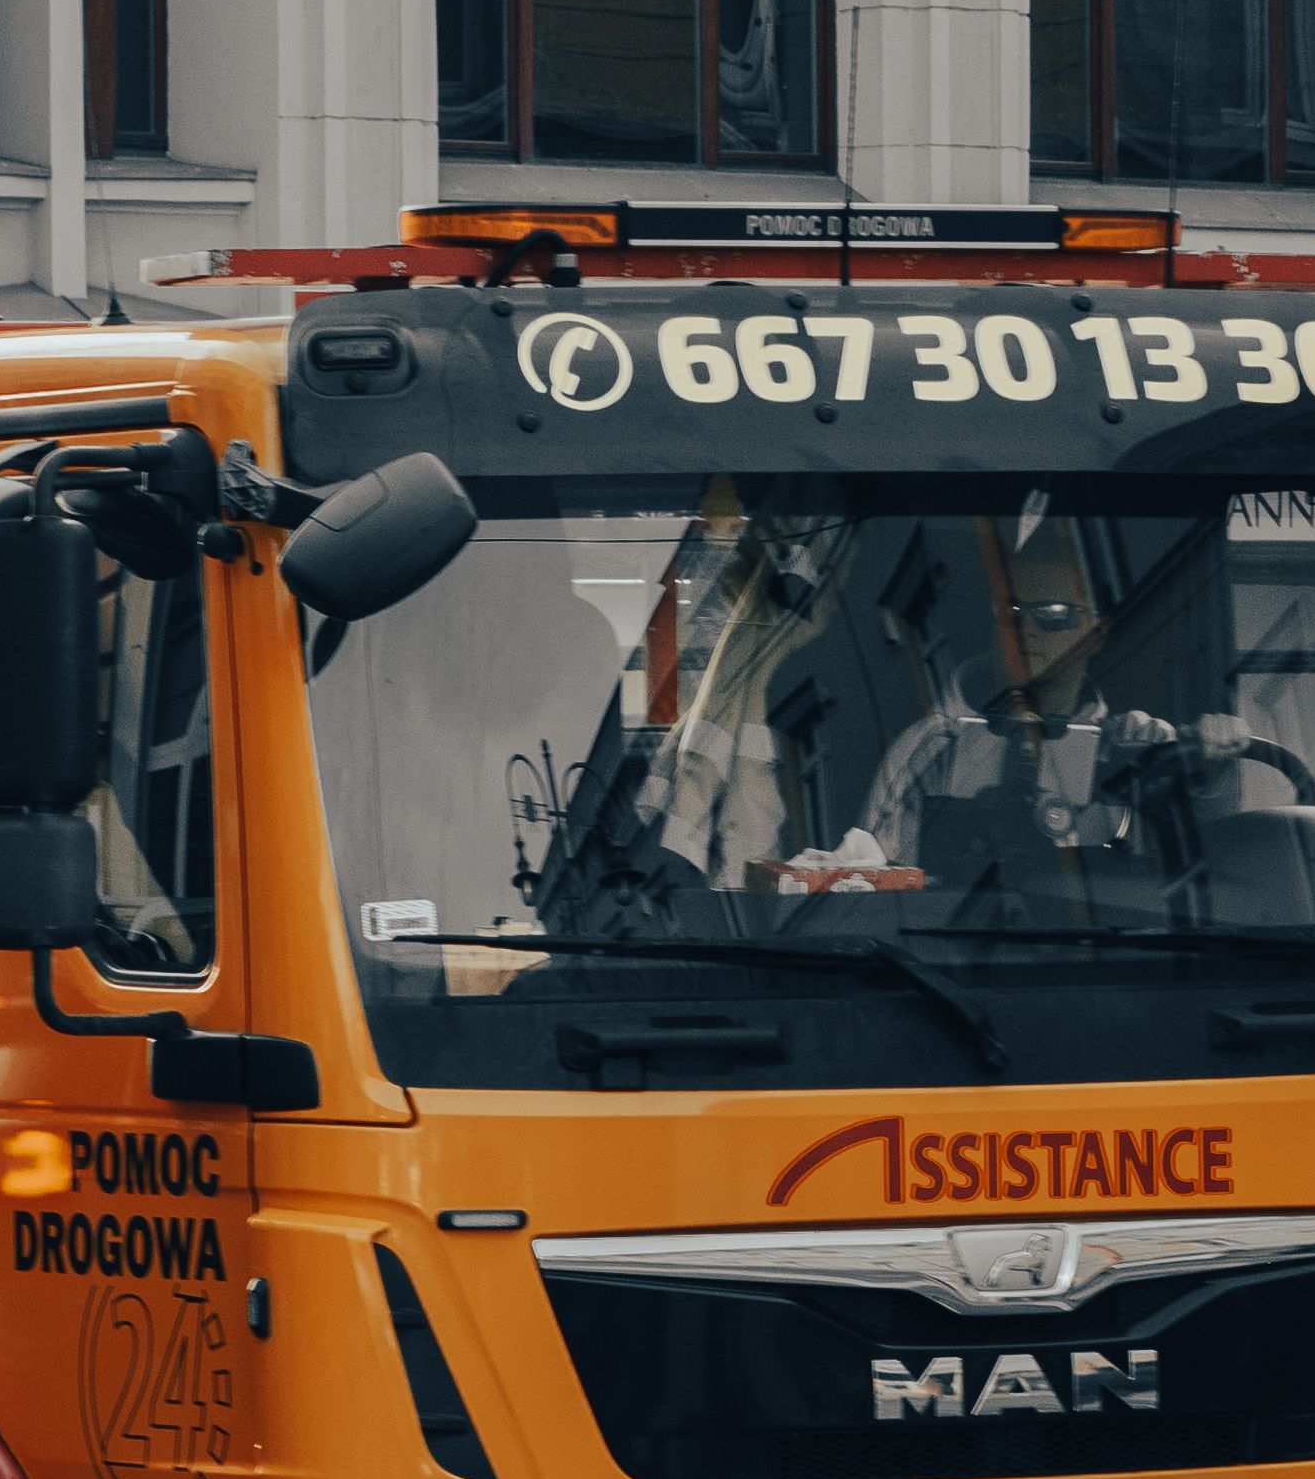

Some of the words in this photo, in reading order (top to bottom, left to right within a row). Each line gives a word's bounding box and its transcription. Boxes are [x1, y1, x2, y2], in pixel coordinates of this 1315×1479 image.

[745, 214, 822, 237] POMOC
[658, 314, 876, 403] 667
[897, 314, 1058, 403] 30
[1071, 314, 1209, 403] 13
[68, 1130, 221, 1197] POMOC
[766, 1115, 1233, 1207] ASSISTANCE
[13, 1210, 227, 1282] DROGOWA
[871, 1349, 1160, 1420] MAN
